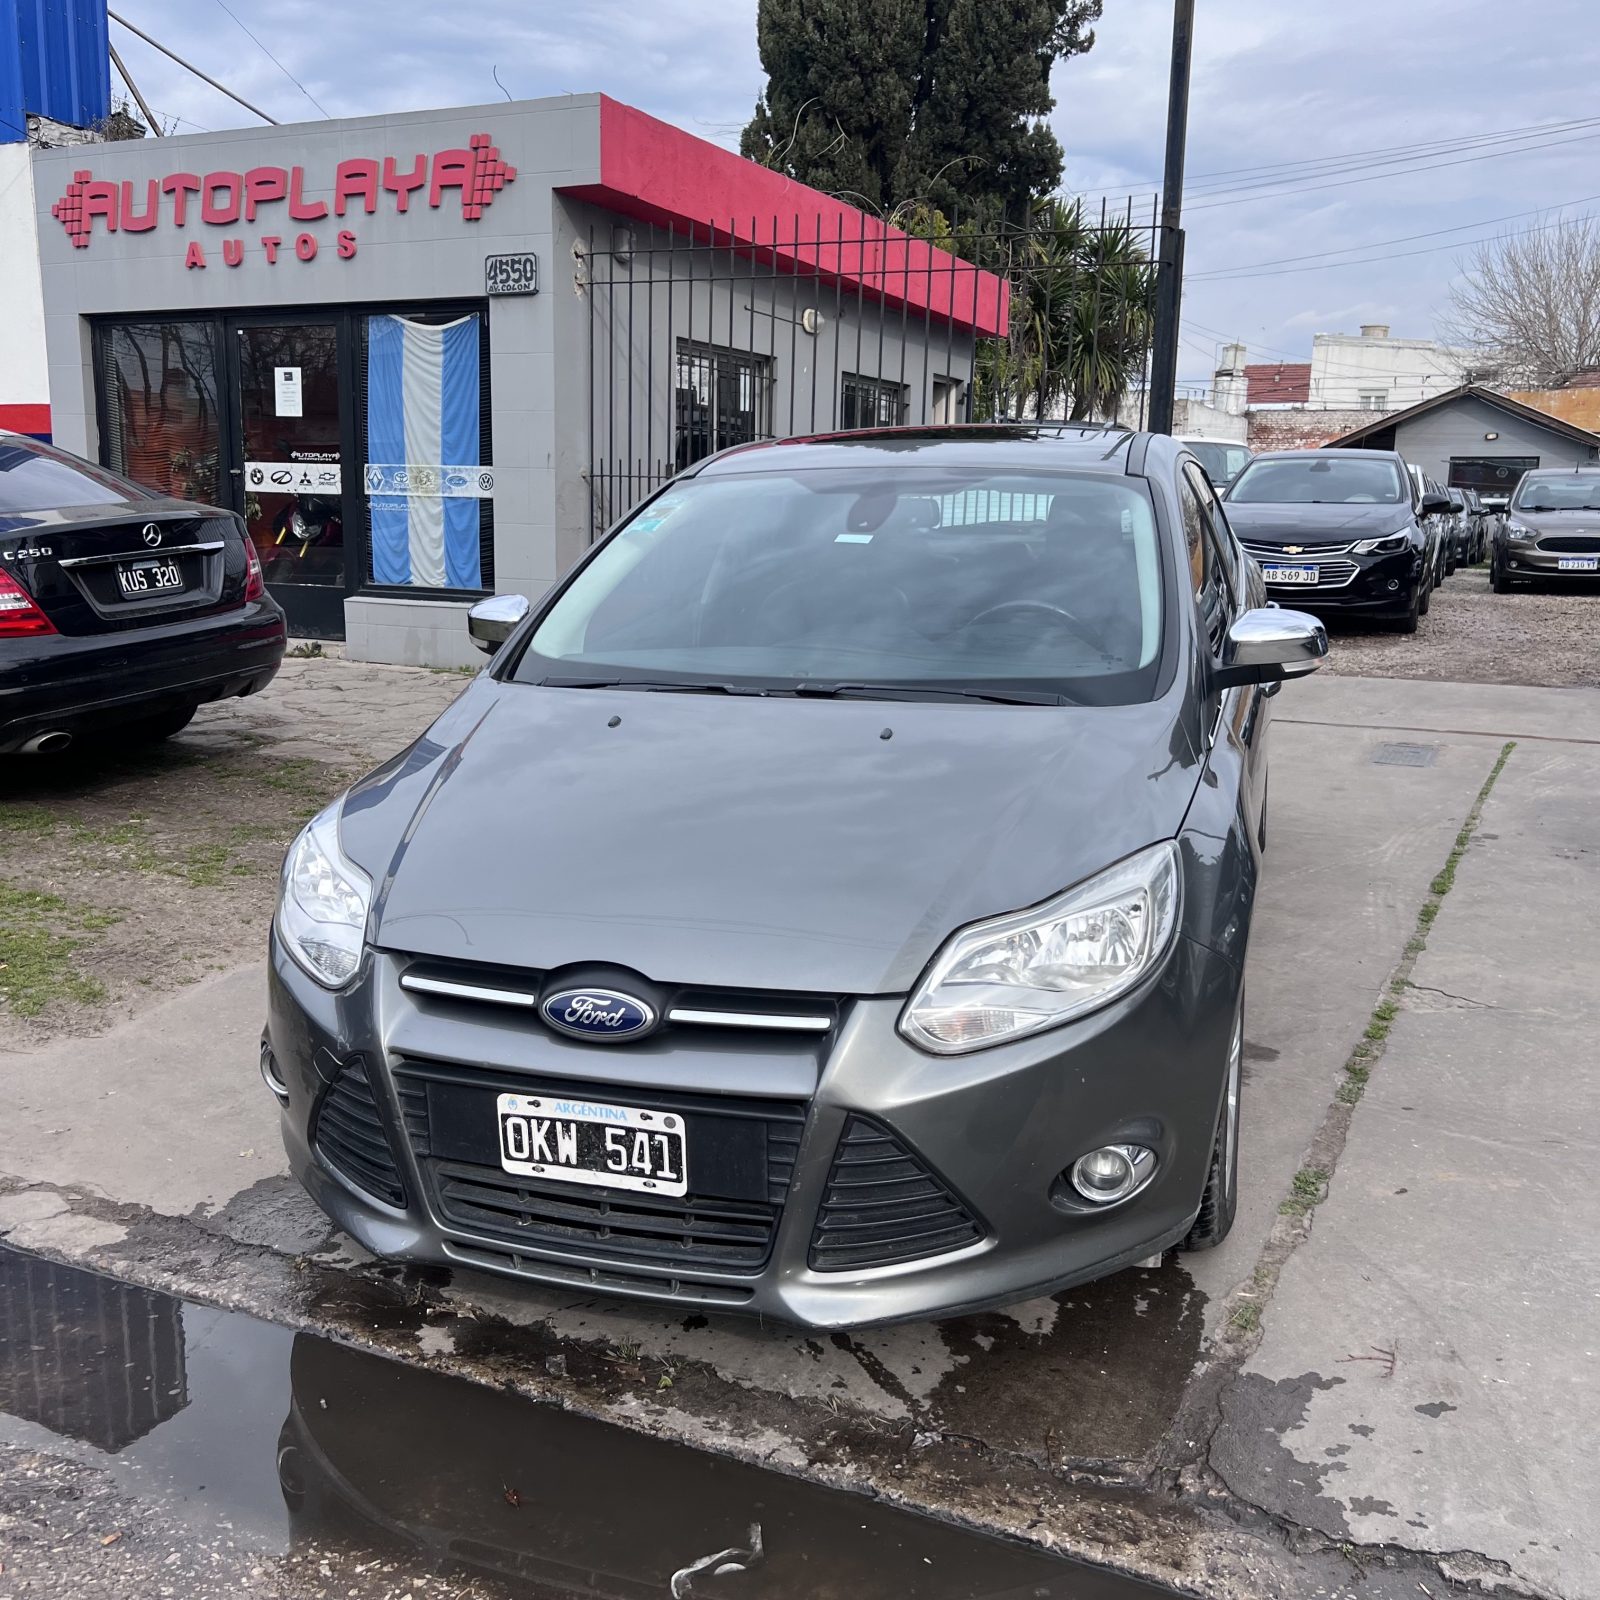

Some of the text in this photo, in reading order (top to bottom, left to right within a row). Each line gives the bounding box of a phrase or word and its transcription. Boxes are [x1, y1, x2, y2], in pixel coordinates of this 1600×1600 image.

[81, 149, 476, 232] AUTOPLAYA
[185, 230, 358, 269] AUTOS
[488, 257, 534, 285] 4550
[294, 451, 338, 460] AUTOPLAYA
[119, 566, 179, 592] KUS 320
[1265, 570, 1316, 581] AB 569 JD
[564, 995, 624, 1028] Ford
[554, 1102, 628, 1121] ARGENTINA
[506, 1116, 678, 1179] OKW 541
